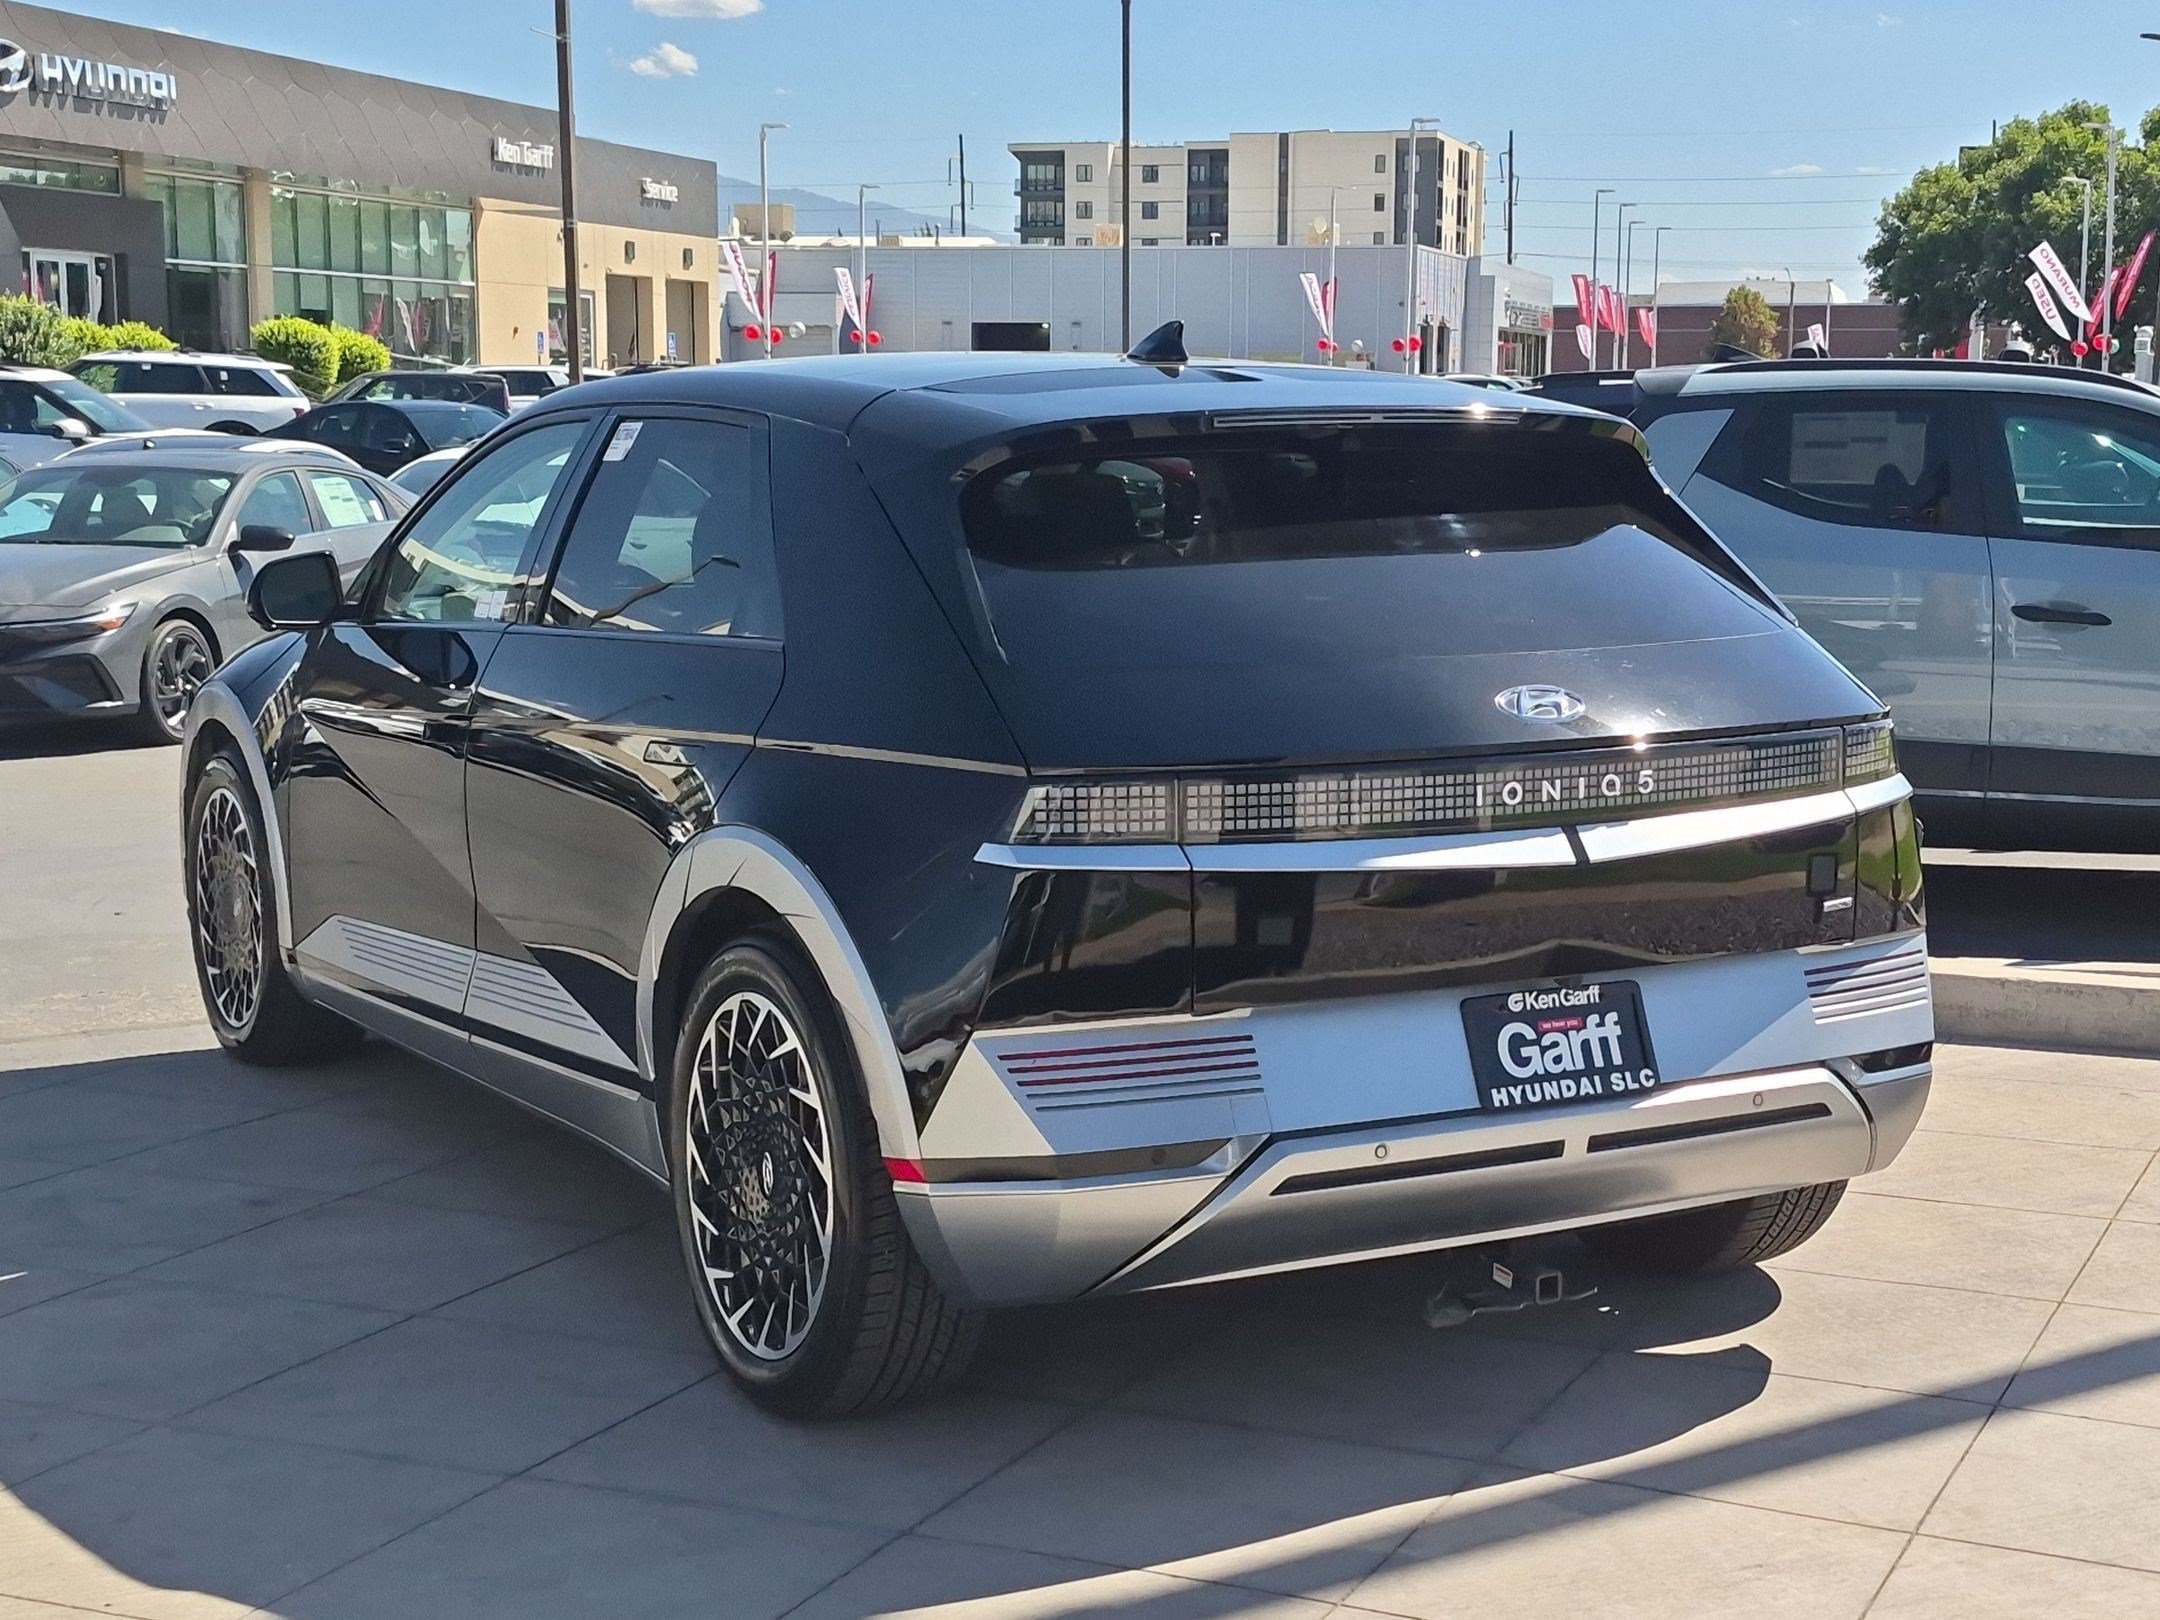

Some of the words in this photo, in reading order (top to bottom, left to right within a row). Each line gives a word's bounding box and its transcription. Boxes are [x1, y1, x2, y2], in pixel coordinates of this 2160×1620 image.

[39, 53, 178, 109] HYUNDAI
[495, 137, 520, 164] Ken
[520, 141, 554, 169] Garff
[641, 178, 679, 202] Service
[1497, 1011, 1623, 1078] Garff
[1491, 1075, 1603, 1107] HYUNDAI
[1610, 1068, 1656, 1092] SLC
